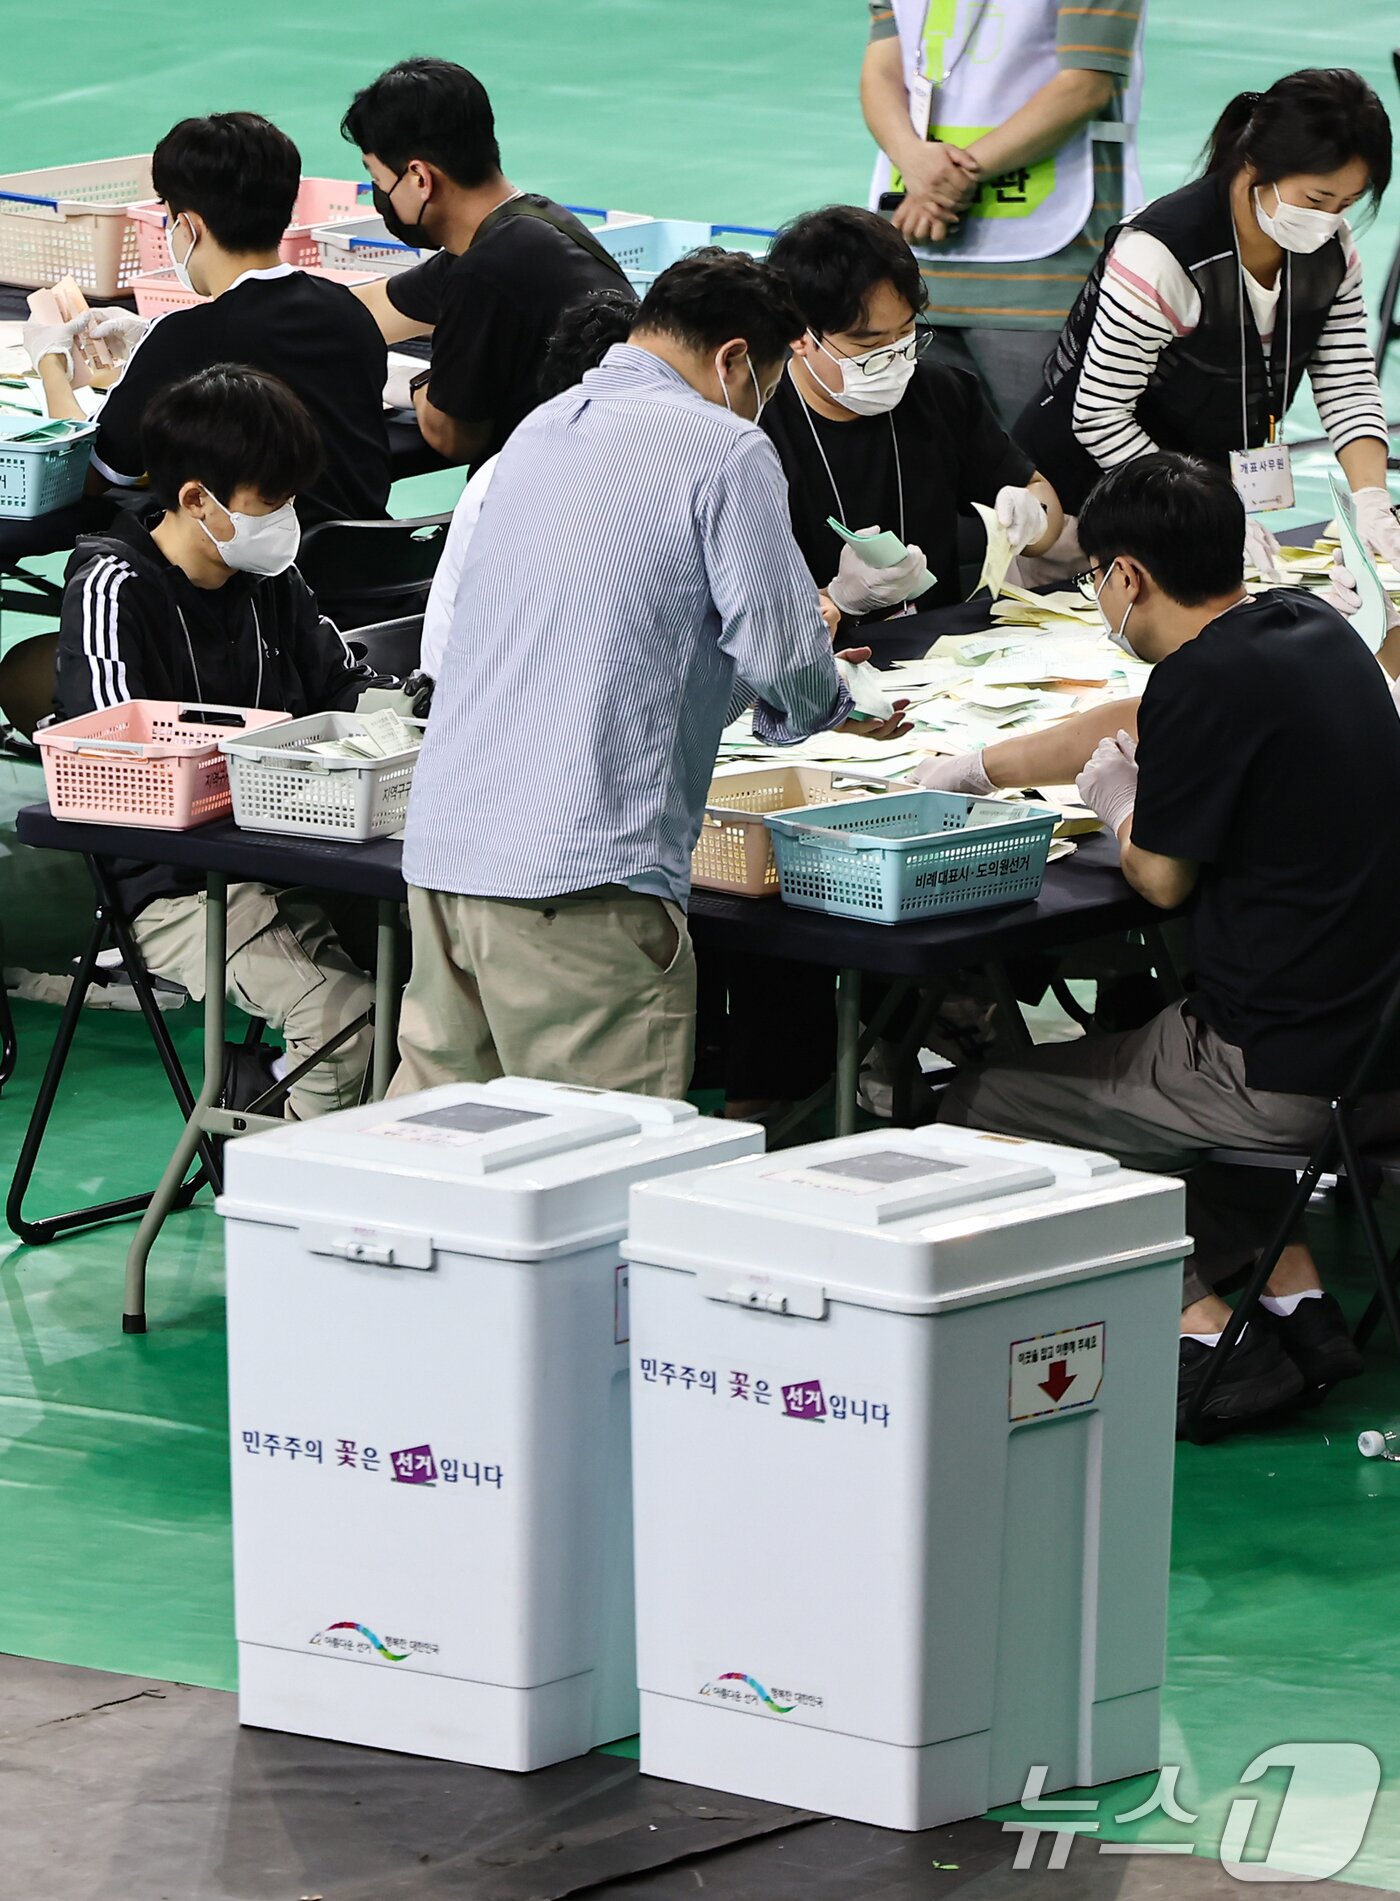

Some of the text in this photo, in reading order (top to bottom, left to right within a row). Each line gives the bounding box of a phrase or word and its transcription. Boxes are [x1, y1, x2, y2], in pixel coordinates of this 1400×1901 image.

[1240, 458, 1284, 474] 개표사무원
[1078, 1336, 1097, 1351] 주세요
[640, 1358, 717, 1395] 민주주의
[729, 1370, 772, 1405] 꽃은
[242, 1431, 323, 1464] 민주주의
[336, 1439, 381, 1472] 꽃은
